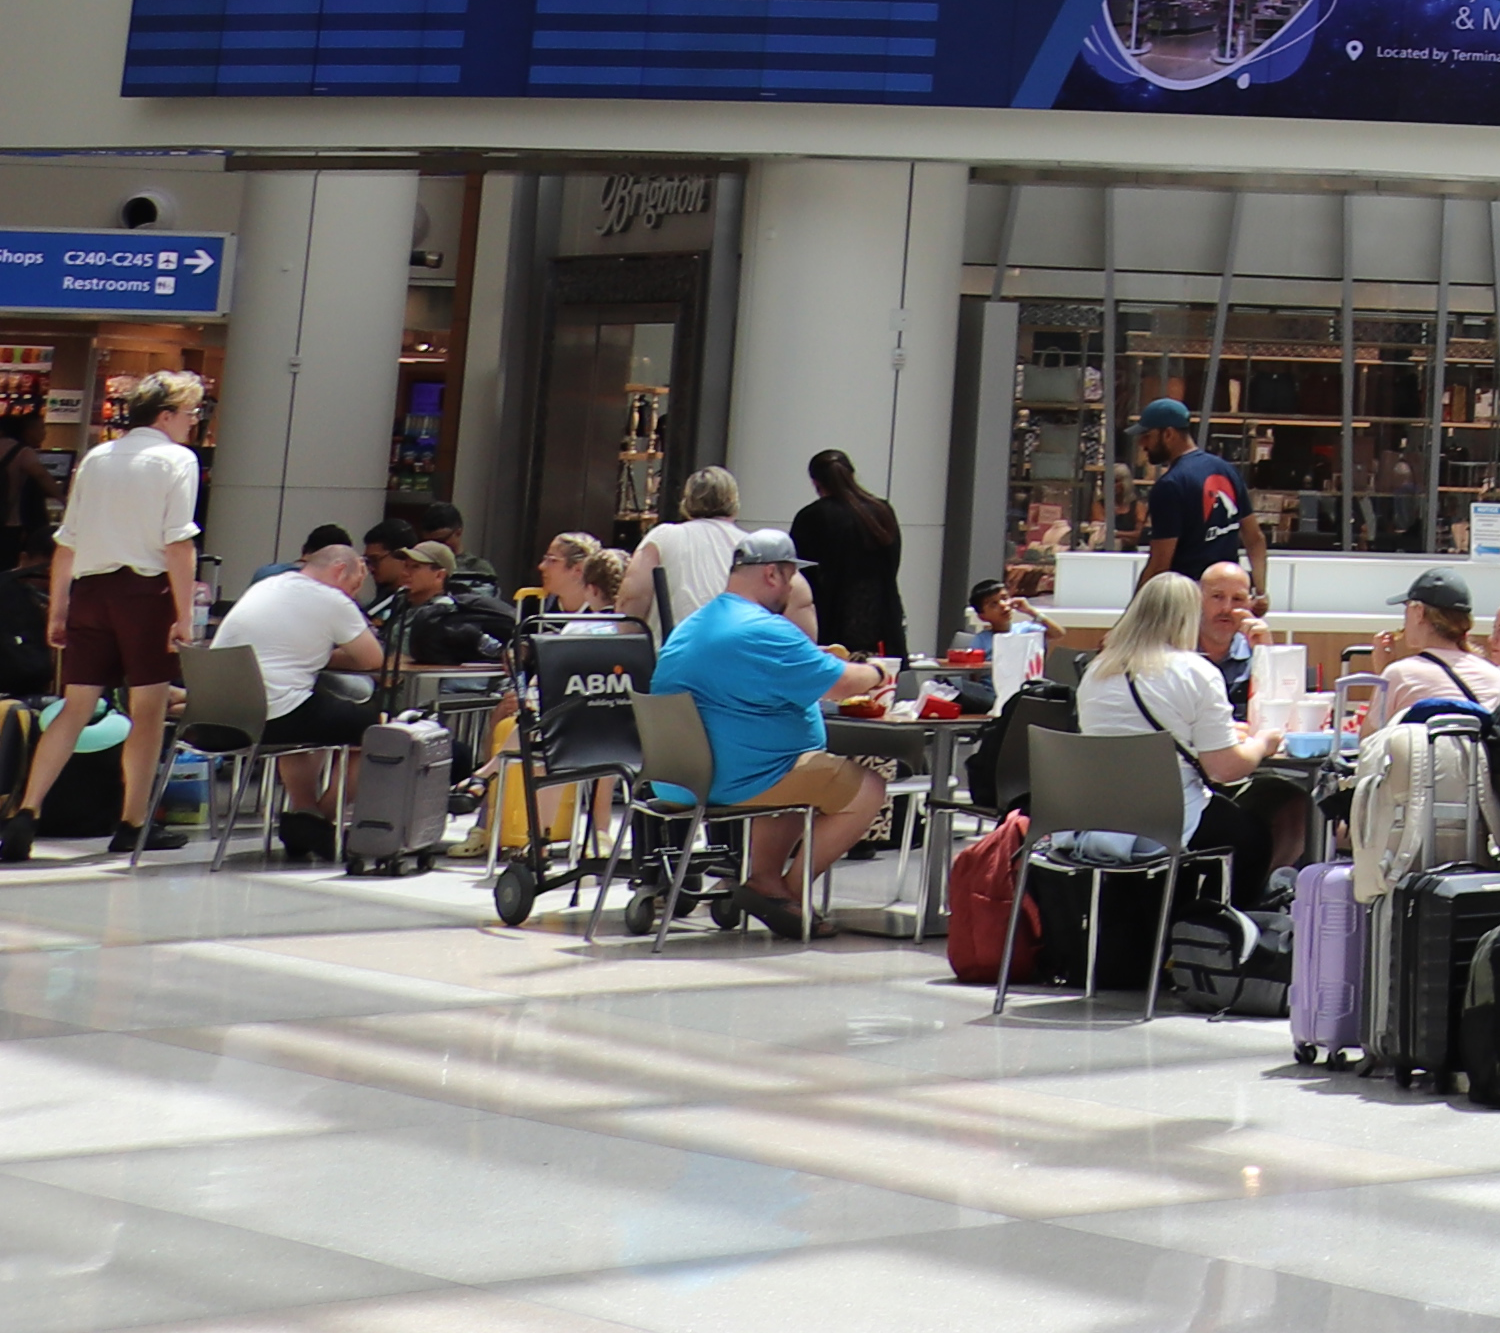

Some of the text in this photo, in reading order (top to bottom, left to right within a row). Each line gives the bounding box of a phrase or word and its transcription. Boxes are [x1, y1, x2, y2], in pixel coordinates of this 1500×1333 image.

[1454, 5, 1476, 31] &
[1376, 46, 1429, 61] Located
[1432, 47, 1449, 63] by
[64, 251, 154, 268] C240-C245
[63, 276, 152, 292] Restrooms
[563, 672, 635, 696] ABM
